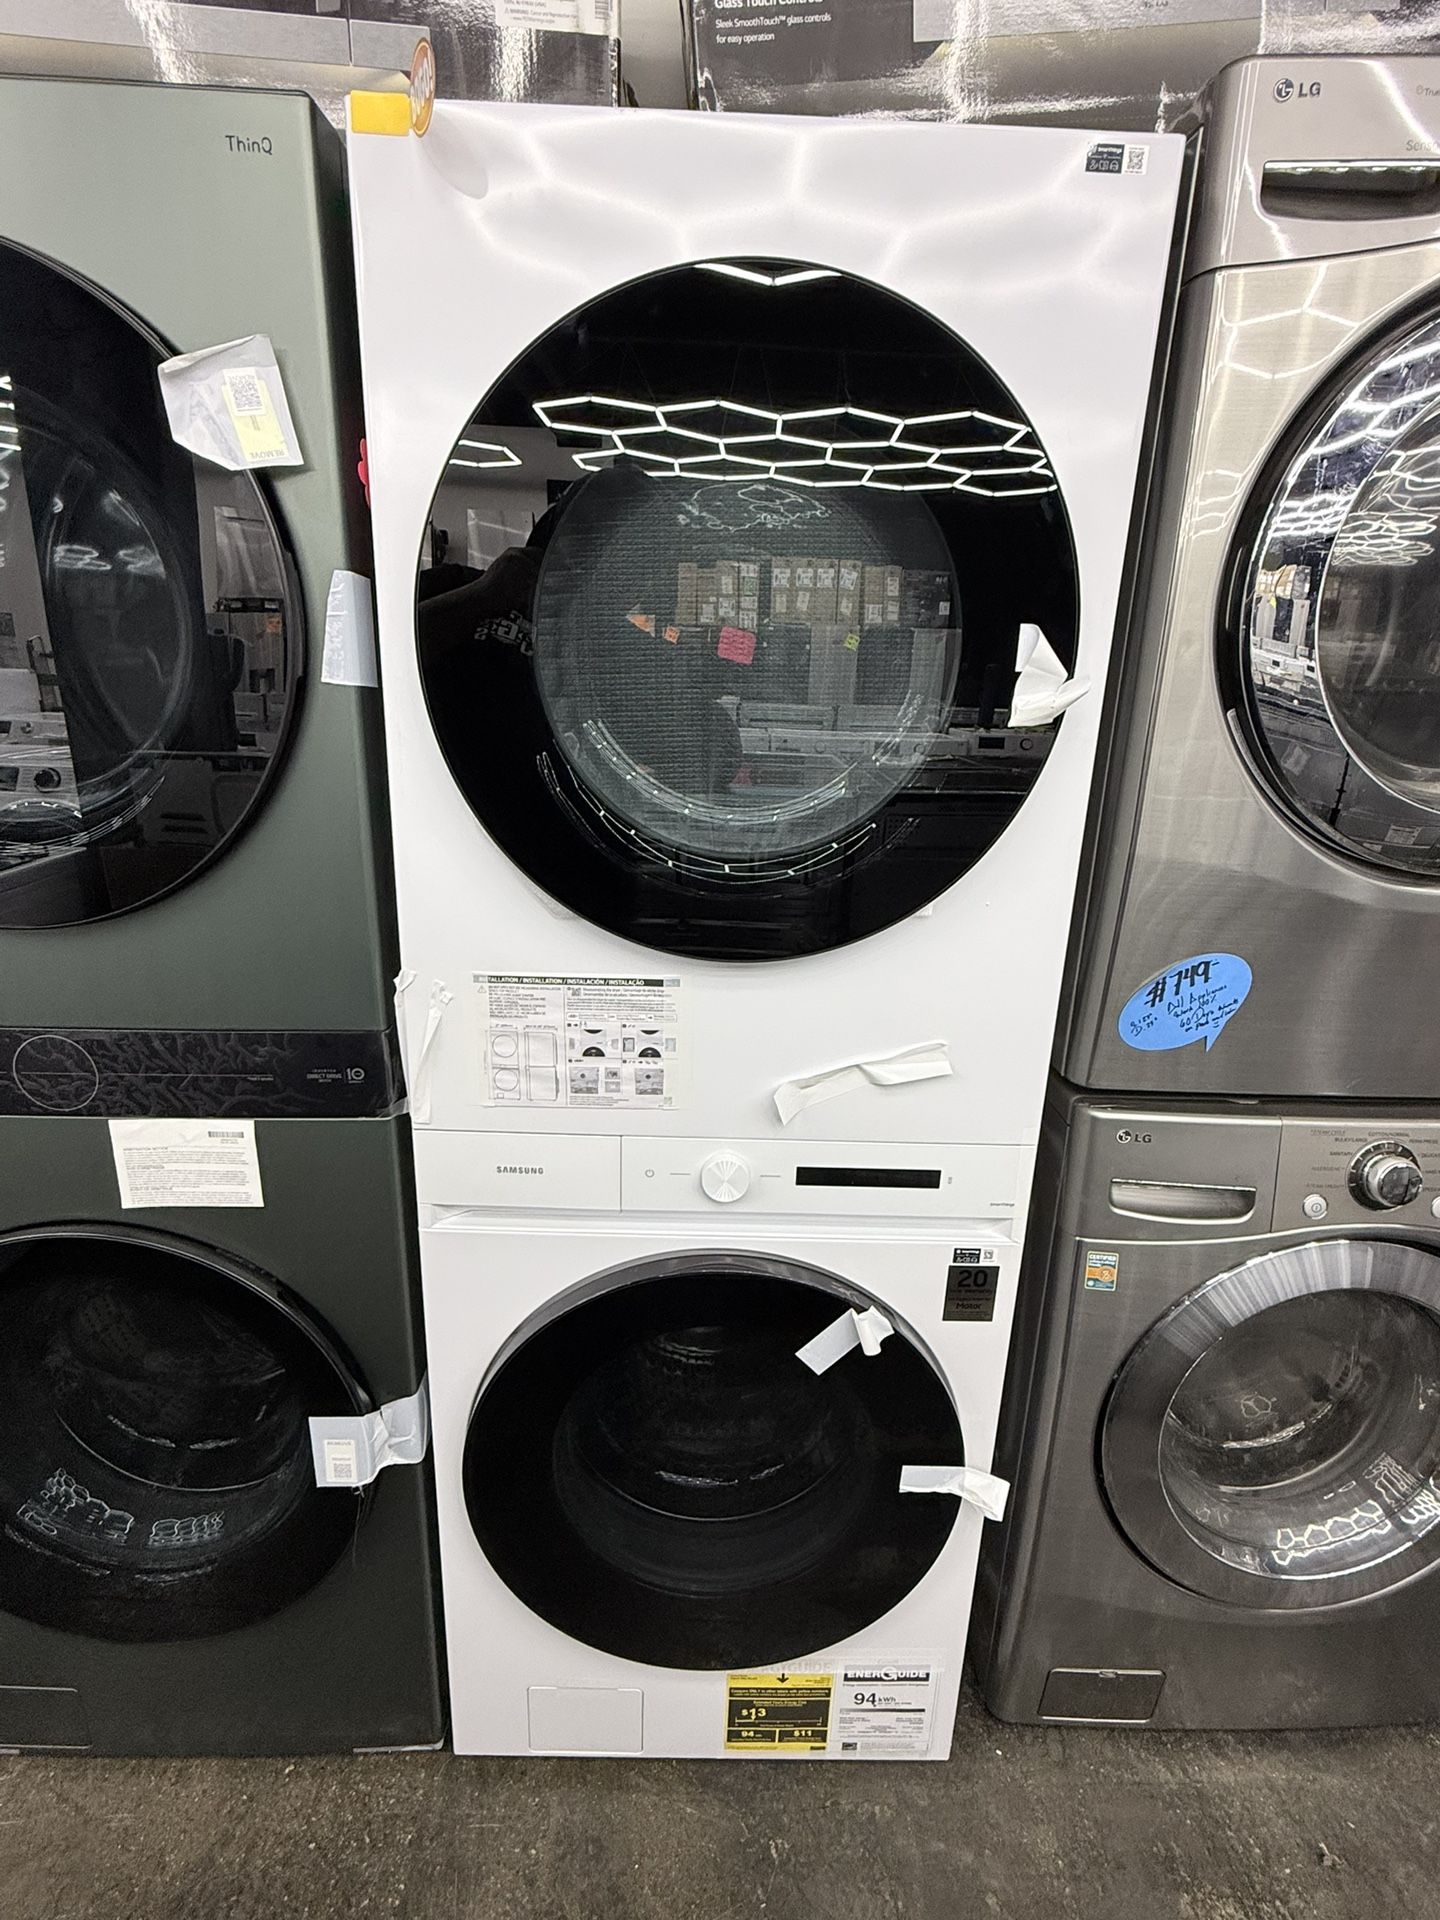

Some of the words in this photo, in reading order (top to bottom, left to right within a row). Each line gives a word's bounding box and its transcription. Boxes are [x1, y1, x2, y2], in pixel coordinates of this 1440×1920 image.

[715, 19, 734, 28] Sleek
[786, 16, 803, 26] glass
[804, 12, 831, 23] controls
[716, 34, 726, 43] for
[727, 35, 742, 44] easy
[743, 33, 775, 43] operation
[1298, 82, 1321, 98] LG
[225, 135, 272, 155] ThinQ
[1134, 1134, 1152, 1143] LG
[496, 1166, 544, 1174] SAMSUNG
[958, 1270, 988, 1287] 20
[854, 1693, 877, 1706] 94
[742, 1708, 767, 1718] $13
